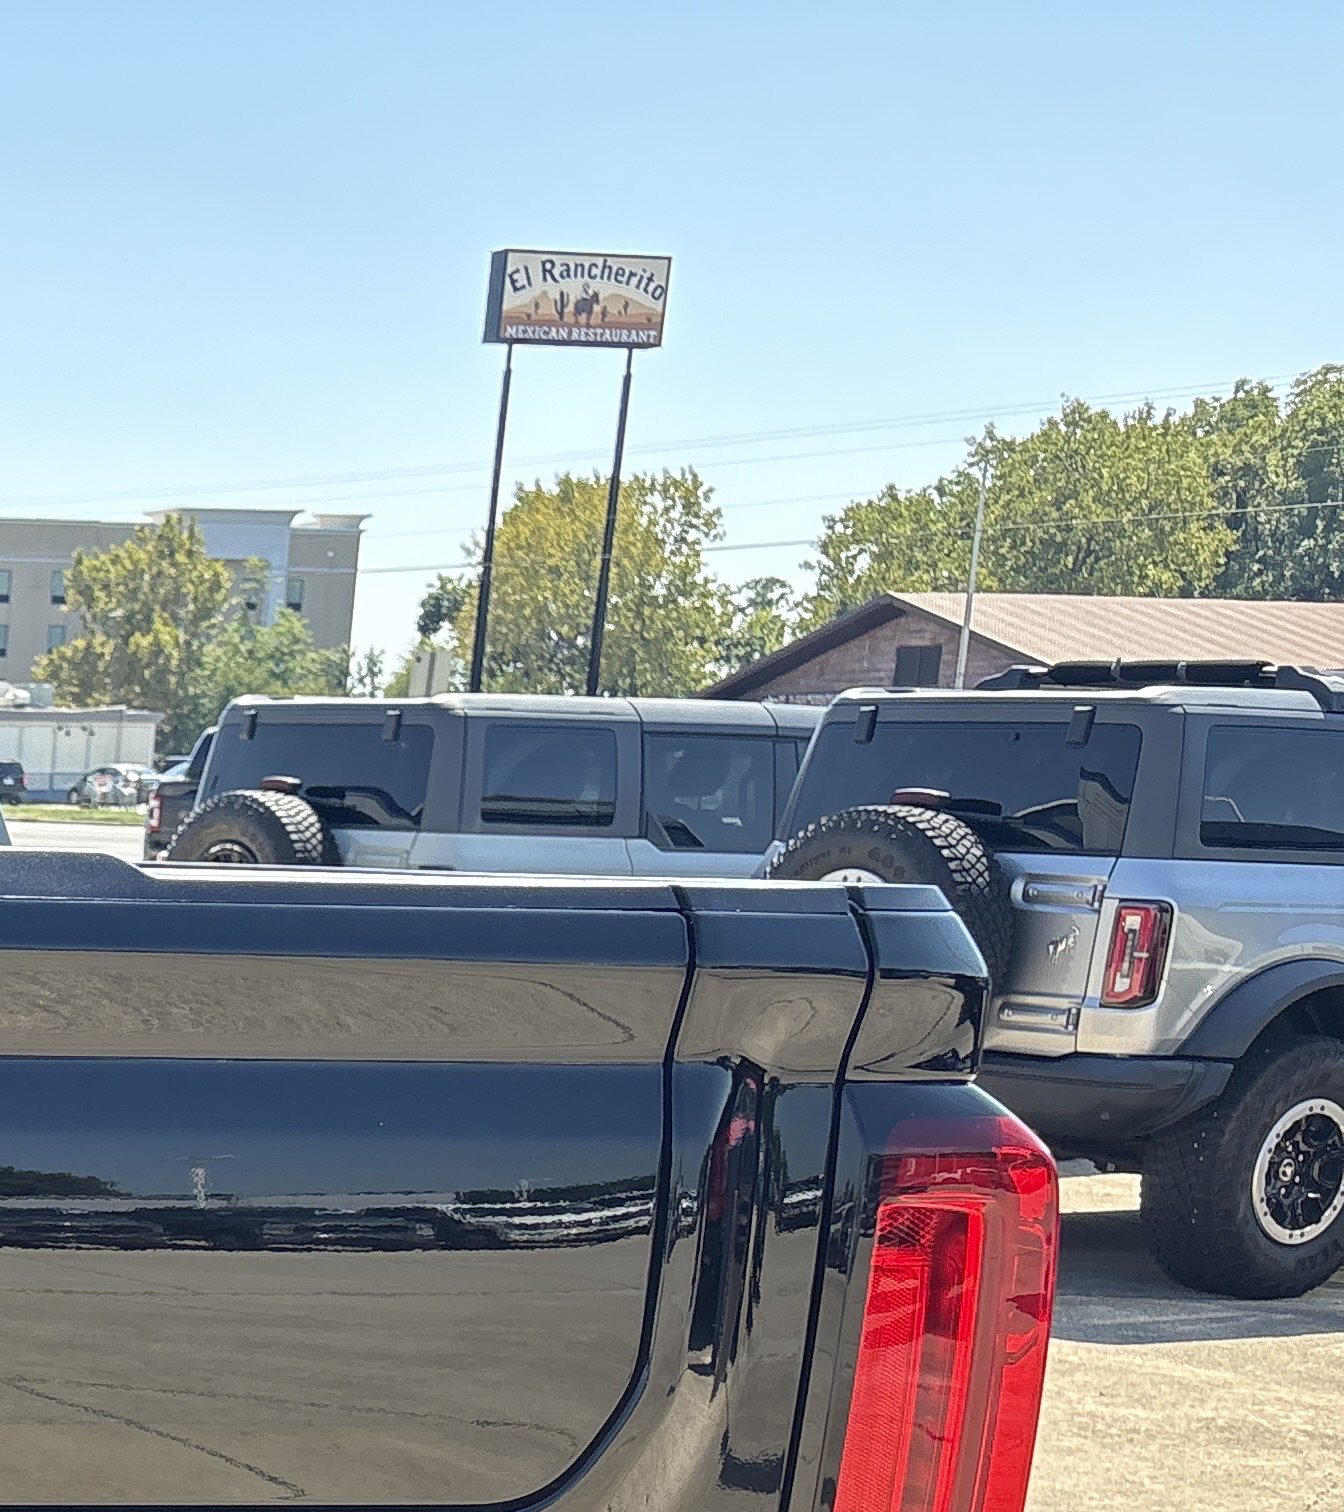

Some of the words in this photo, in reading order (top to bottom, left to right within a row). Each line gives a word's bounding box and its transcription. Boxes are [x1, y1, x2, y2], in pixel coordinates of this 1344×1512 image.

[507, 265, 533, 294] El
[540, 258, 666, 302] Rancherito
[504, 325, 569, 341] MEXICAN
[571, 327, 659, 344] RESTAURANT
